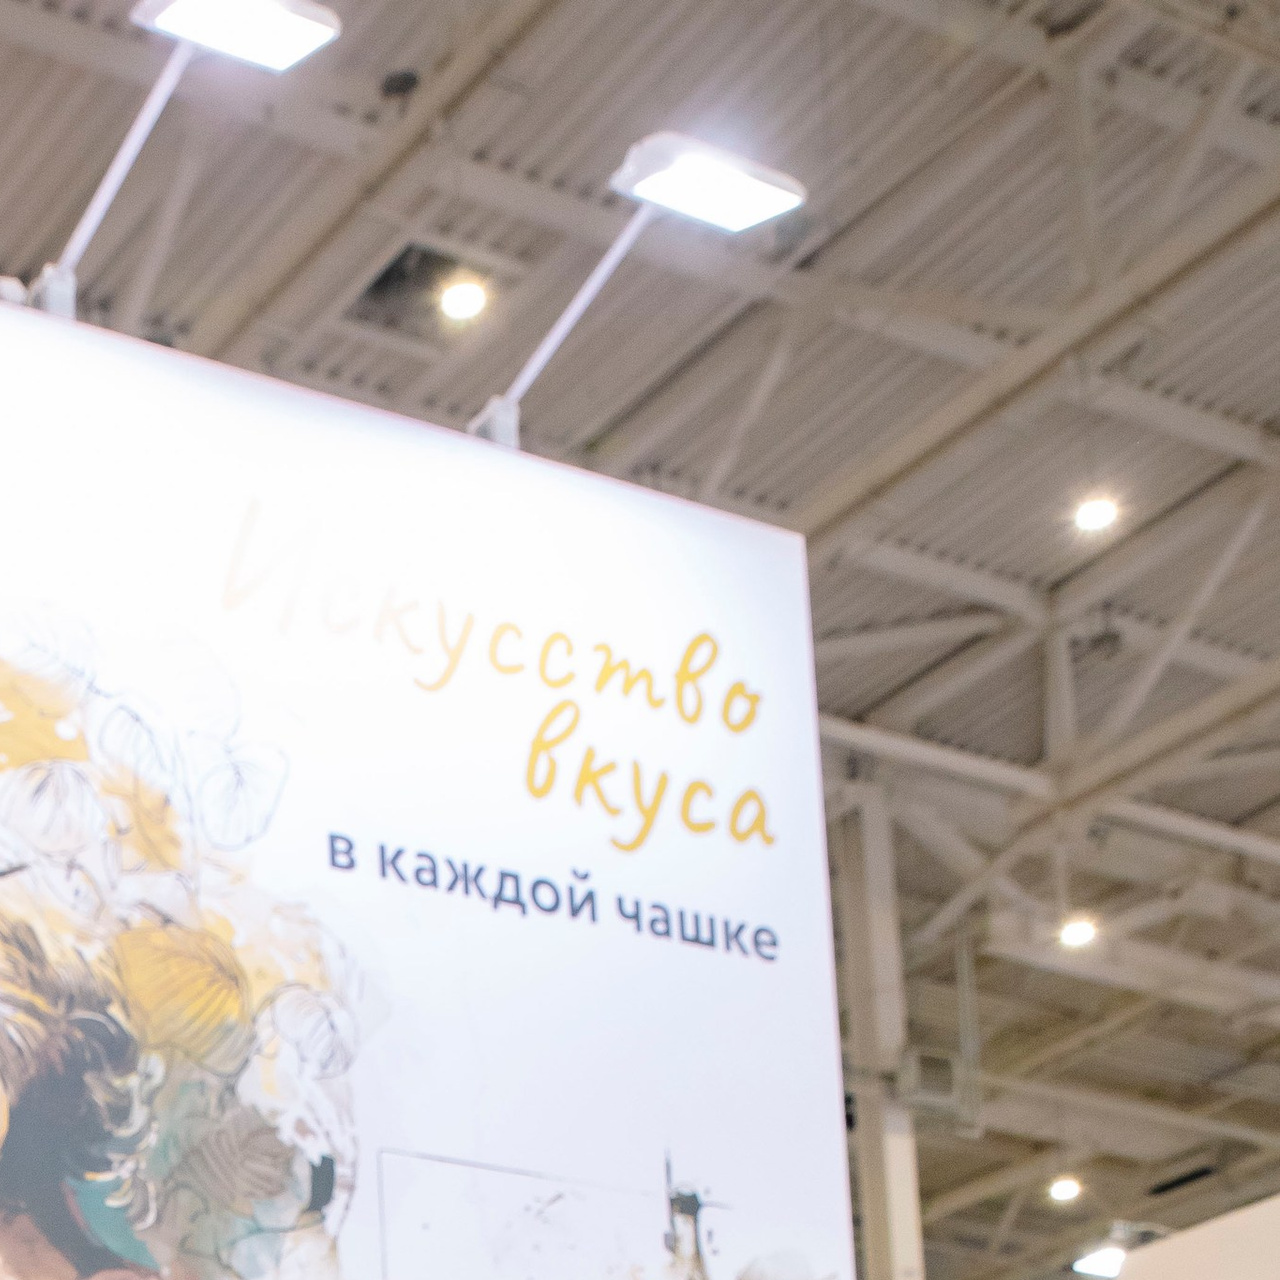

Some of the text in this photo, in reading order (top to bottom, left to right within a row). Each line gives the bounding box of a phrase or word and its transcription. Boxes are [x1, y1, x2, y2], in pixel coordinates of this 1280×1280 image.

[526, 700, 775, 852] вкуса
[327, 833, 780, 963] в каждой чашке
